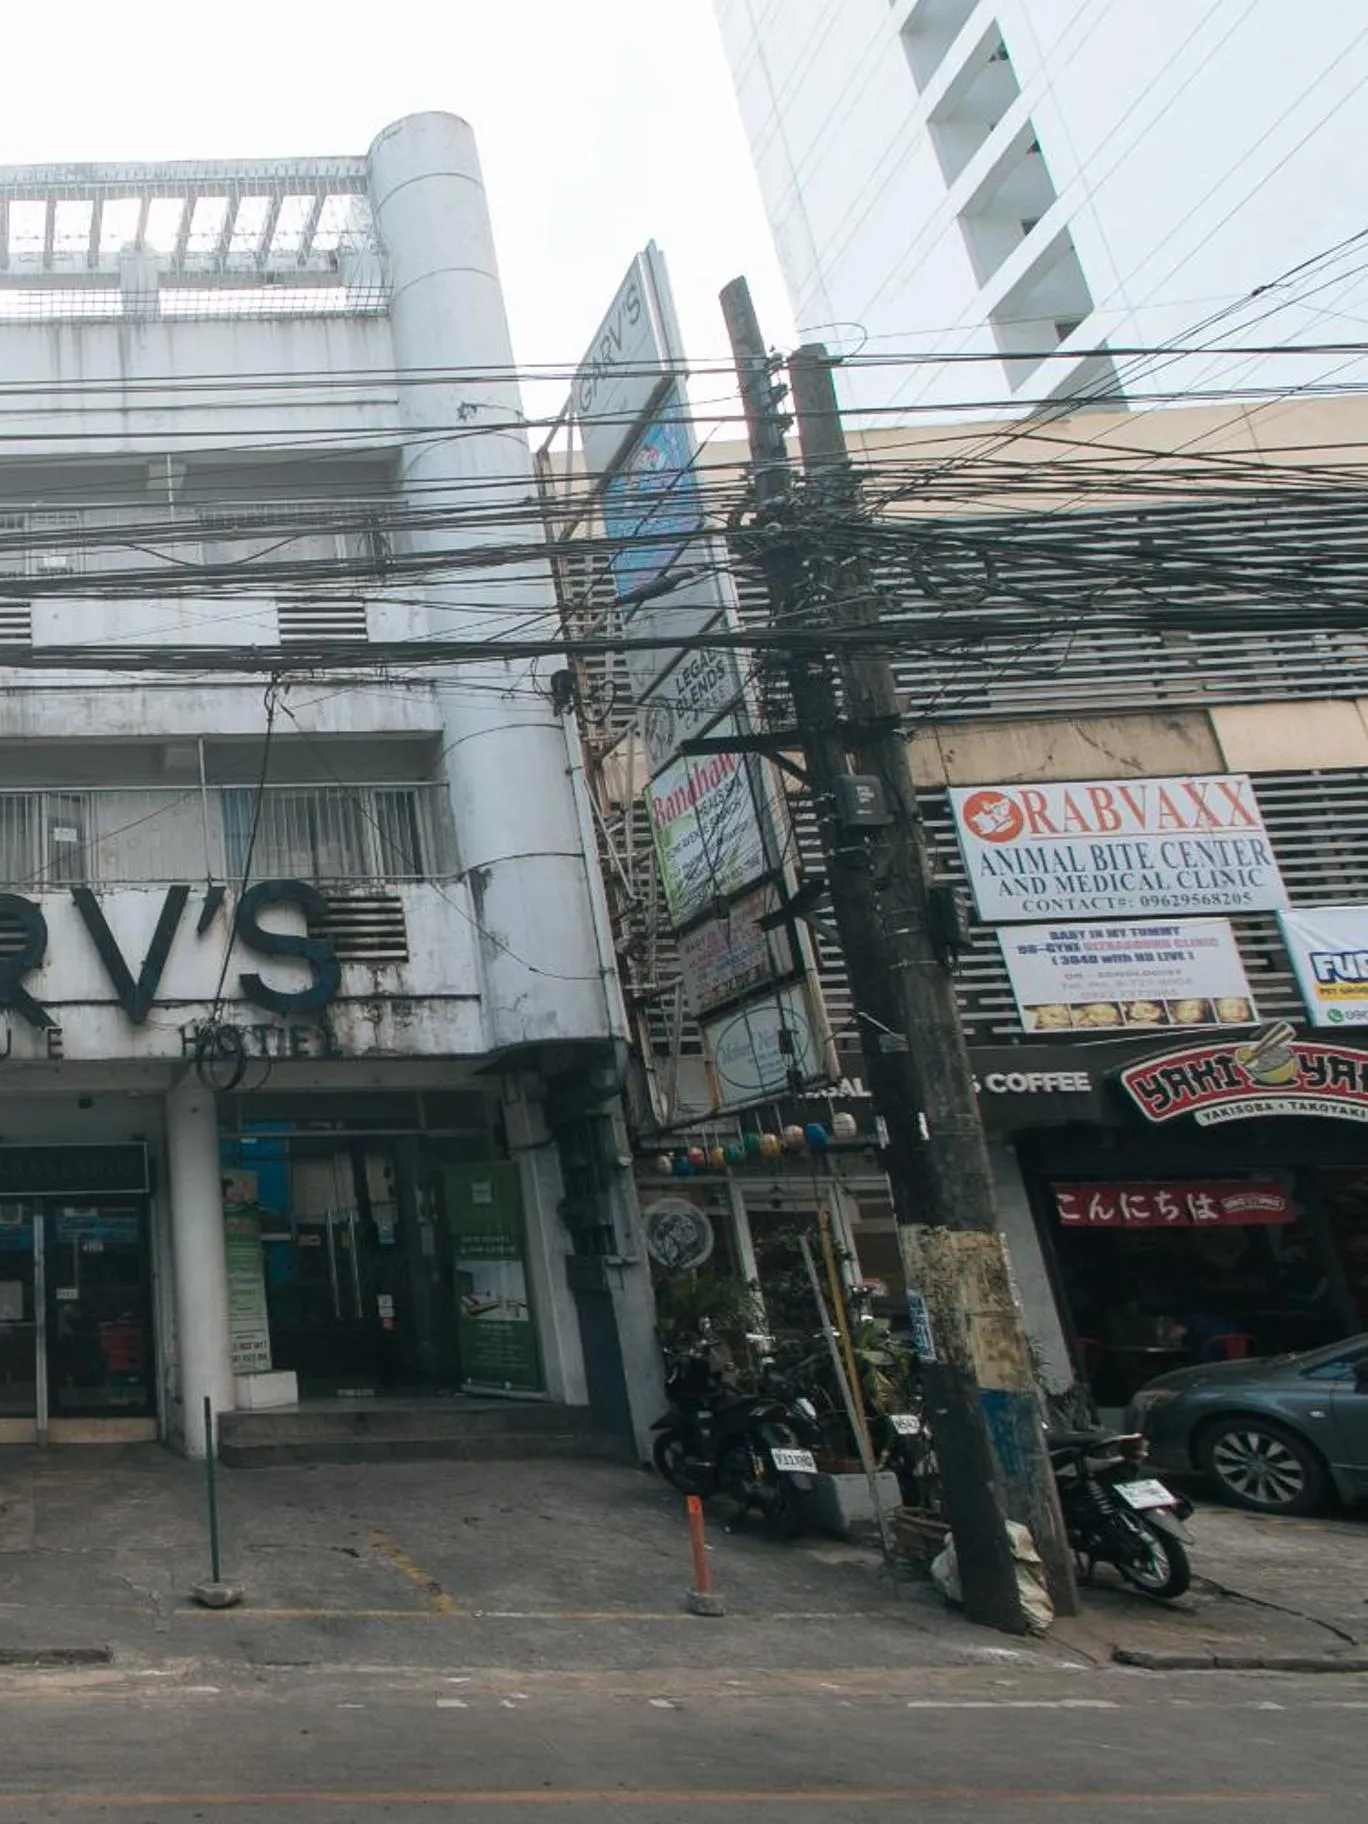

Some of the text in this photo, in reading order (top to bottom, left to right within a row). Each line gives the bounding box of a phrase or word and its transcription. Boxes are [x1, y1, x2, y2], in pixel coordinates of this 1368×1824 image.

[579, 284, 642, 413] GARV'S
[1020, 780, 1260, 834] RABVAXX
[979, 837, 1272, 877] ANIMAL BITE CENTER
[998, 868, 1264, 897] AND MEDICAL CLINIC
[985, 1071, 1092, 1093] COFFEE
[1134, 1055, 1245, 1111] YAKI
[1202, 1101, 1367, 1121] YAKISOBA TAKOYAKI
[1056, 1191, 1219, 1222] こんにちは
